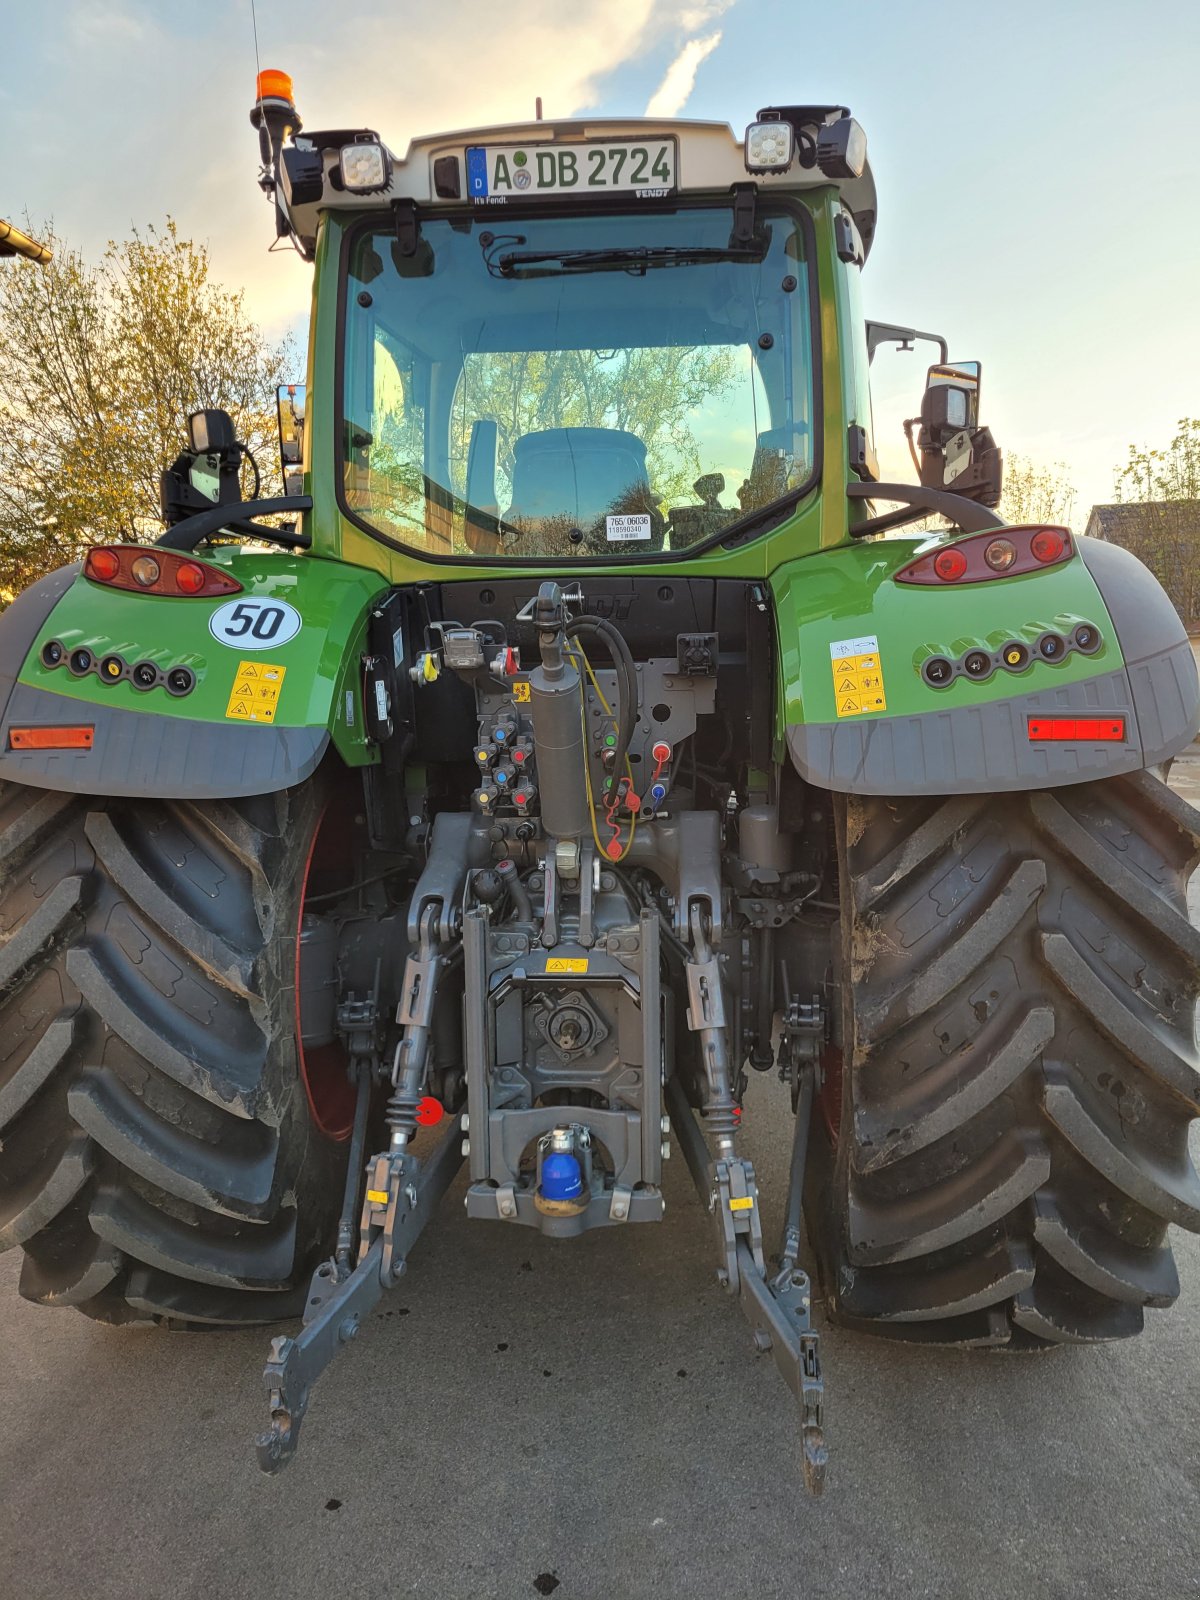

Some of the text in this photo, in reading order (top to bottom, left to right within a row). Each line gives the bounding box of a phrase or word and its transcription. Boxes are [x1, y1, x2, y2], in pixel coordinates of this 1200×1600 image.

[493, 146, 670, 190] A DB 2724
[475, 178, 482, 189] D
[635, 189, 670, 198] FENDT
[224, 604, 285, 640] 50
